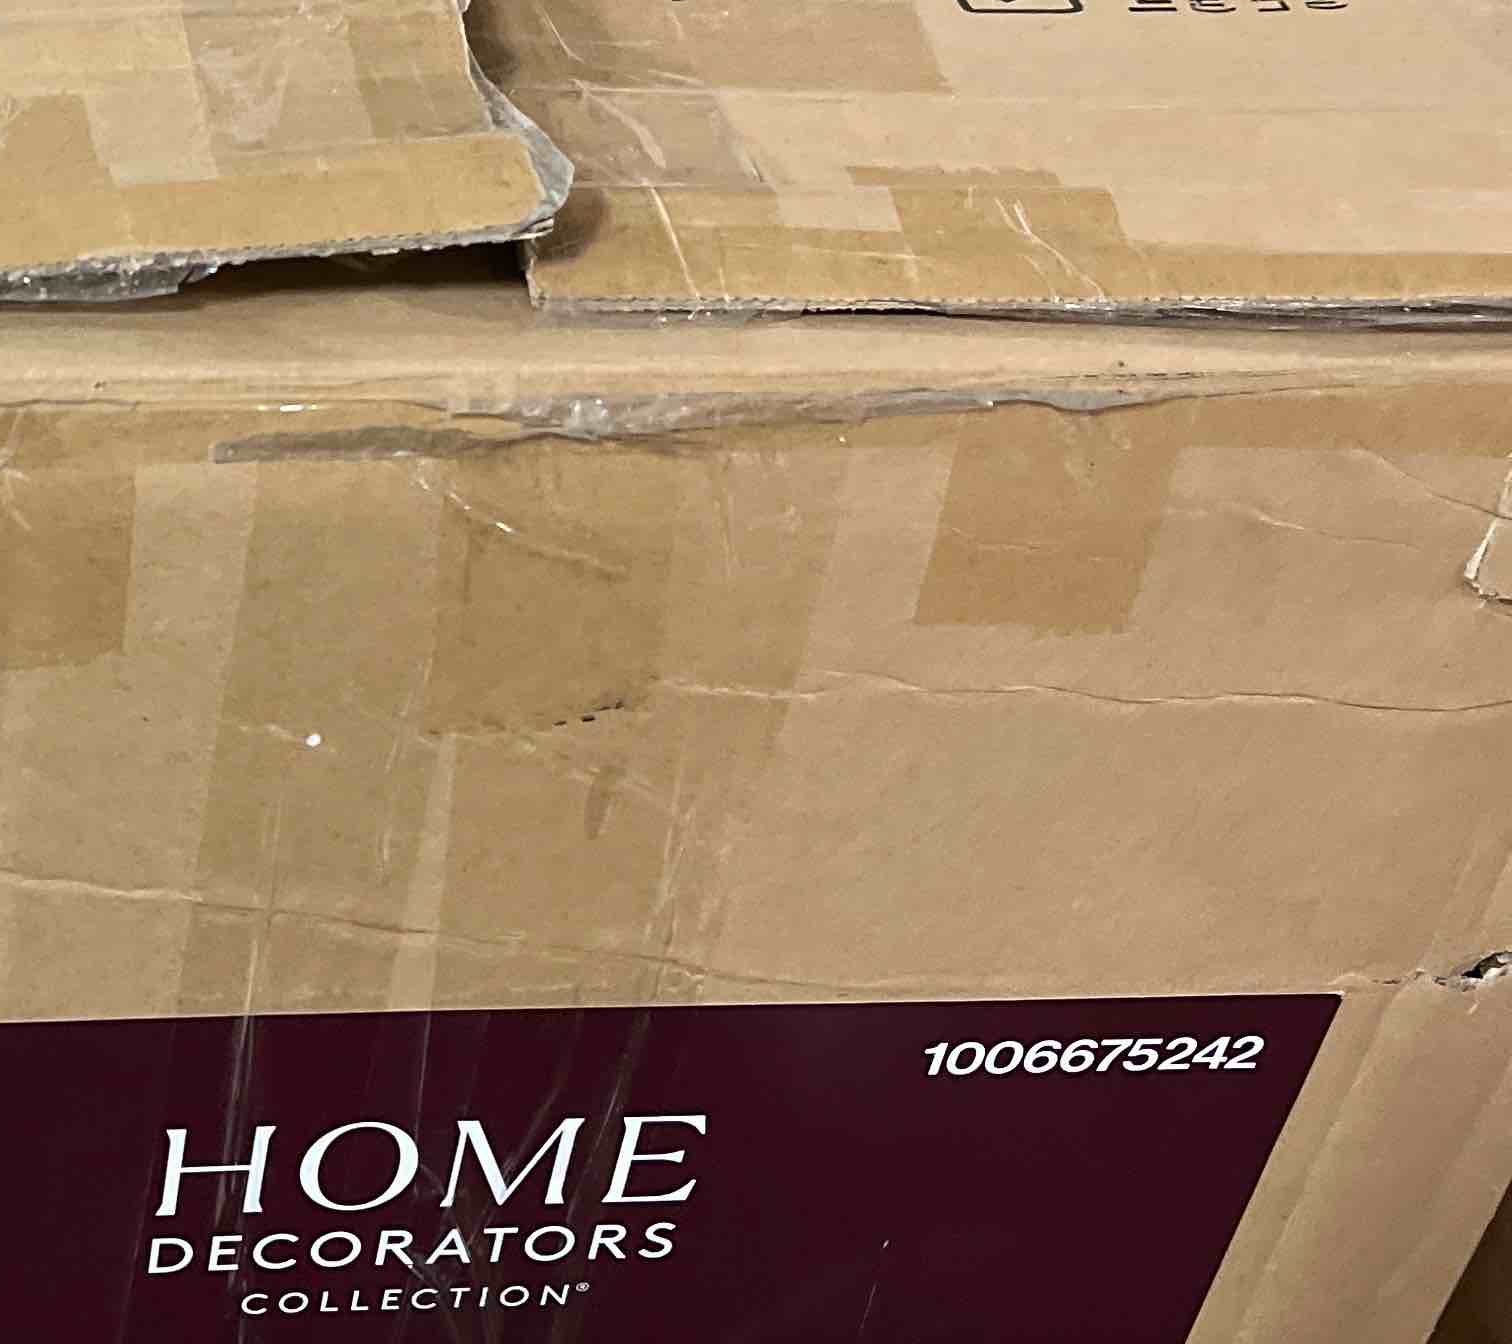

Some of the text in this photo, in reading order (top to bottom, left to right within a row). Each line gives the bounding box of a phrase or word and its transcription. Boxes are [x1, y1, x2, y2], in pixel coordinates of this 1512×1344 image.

[923, 1034, 1265, 1076] 1006675242
[154, 1113, 709, 1217] HOME
[146, 1221, 679, 1275] DECORATORS
